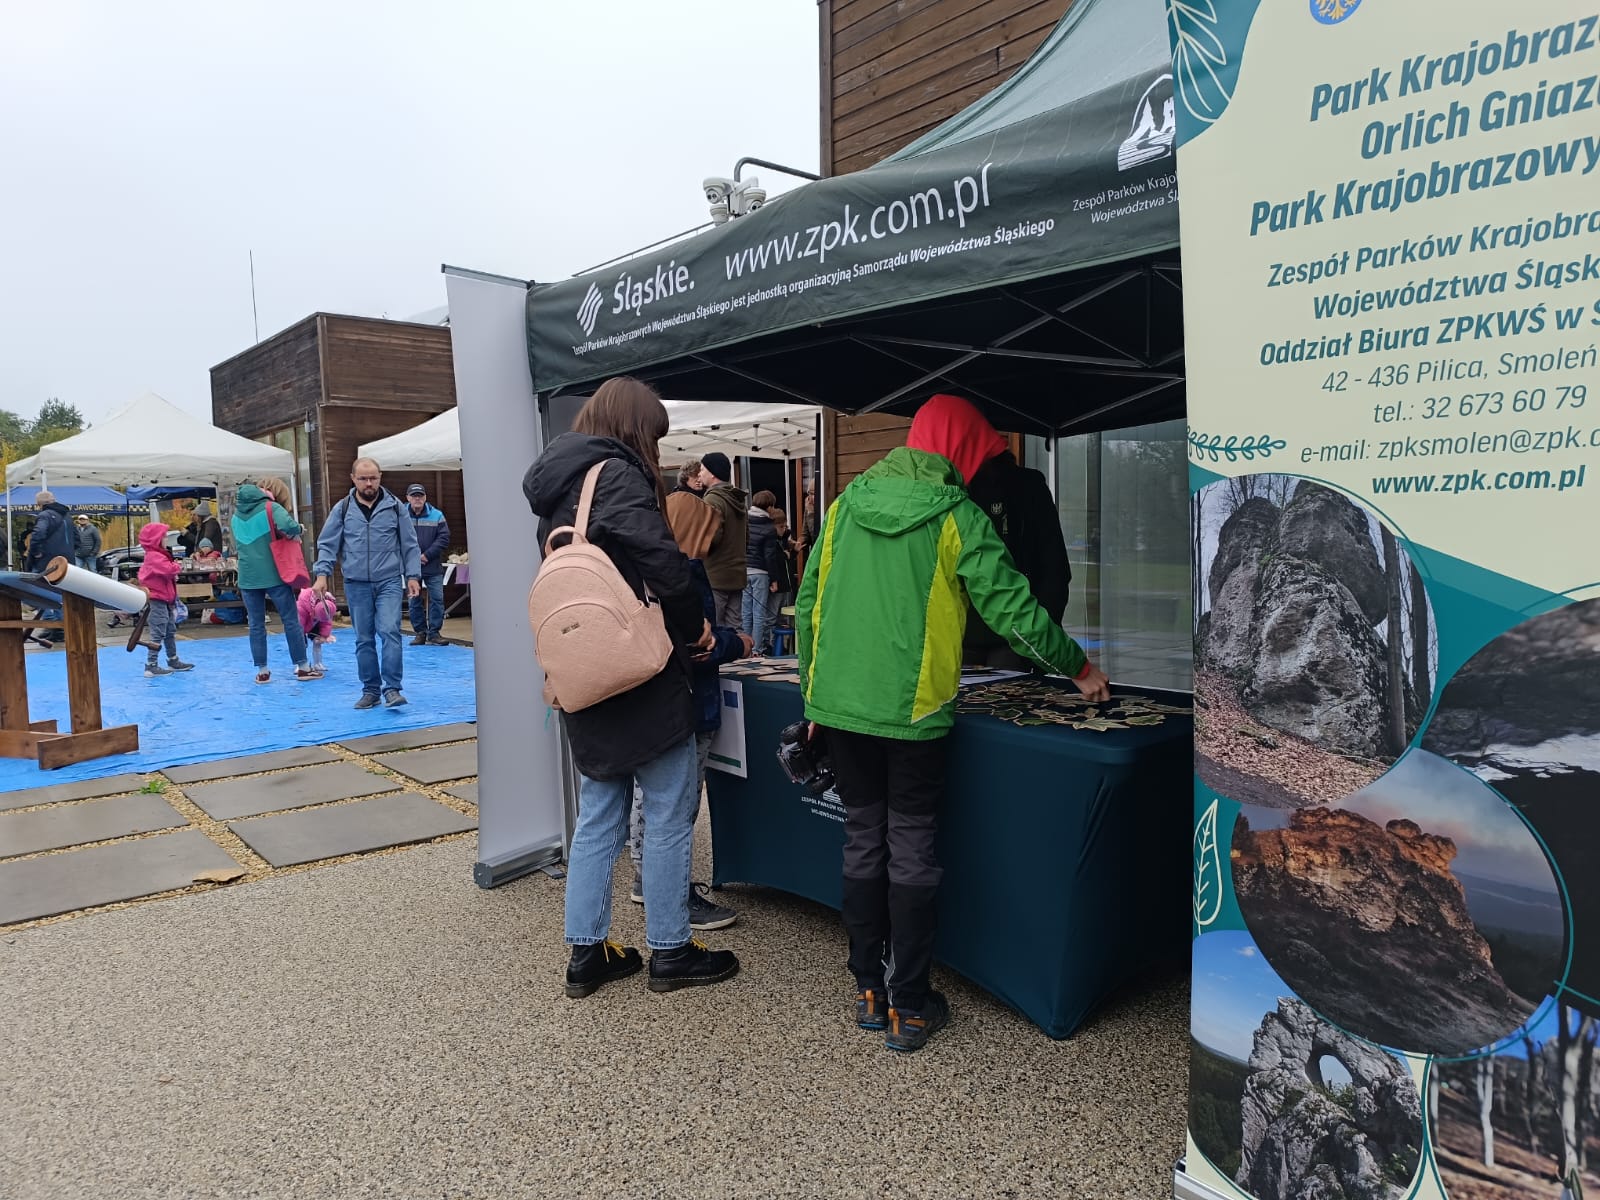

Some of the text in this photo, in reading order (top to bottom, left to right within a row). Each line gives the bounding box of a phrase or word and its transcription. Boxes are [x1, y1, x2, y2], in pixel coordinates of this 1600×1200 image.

[1310, 14, 1600, 121] Park Krajobraz
[1360, 75, 1600, 159] Orlich Gniaz
[1072, 170, 1178, 211] Zespół Parków Krajo
[1091, 188, 1180, 223] Województwa Śl
[1250, 136, 1600, 236] Park Krajobrazowy
[725, 162, 995, 281] www.zpk.com.pl
[608, 322, 652, 346] Krajobrazowych
[652, 311, 696, 332] Województwa
[697, 302, 730, 320] Śląskiego
[730, 294, 746, 312] jest
[746, 282, 788, 307] jednostką
[789, 267, 852, 294] organizacyjną
[853, 254, 908, 278] Samorządu
[910, 233, 991, 262] Województwa
[994, 218, 1055, 245] Śląskiego
[1267, 251, 1350, 287] Zespół
[1355, 232, 1463, 273] Parków
[612, 260, 695, 316] Śląskie.
[1313, 270, 1507, 320] Województwa
[1260, 331, 1352, 366] Oddział
[1358, 324, 1430, 354] Biura
[1437, 302, 1547, 344] ZPKWŚ
[1555, 306, 1584, 330] w
[1322, 370, 1348, 393] 42
[1367, 364, 1409, 389] 436
[1417, 355, 1488, 385] Pilica,
[1498, 344, 1597, 375] Smoleń
[1373, 385, 1587, 424] tel.: 32 673 60 79
[1301, 439, 1370, 463] e-mail:
[1372, 465, 1586, 494] www.zpk.com.pl
